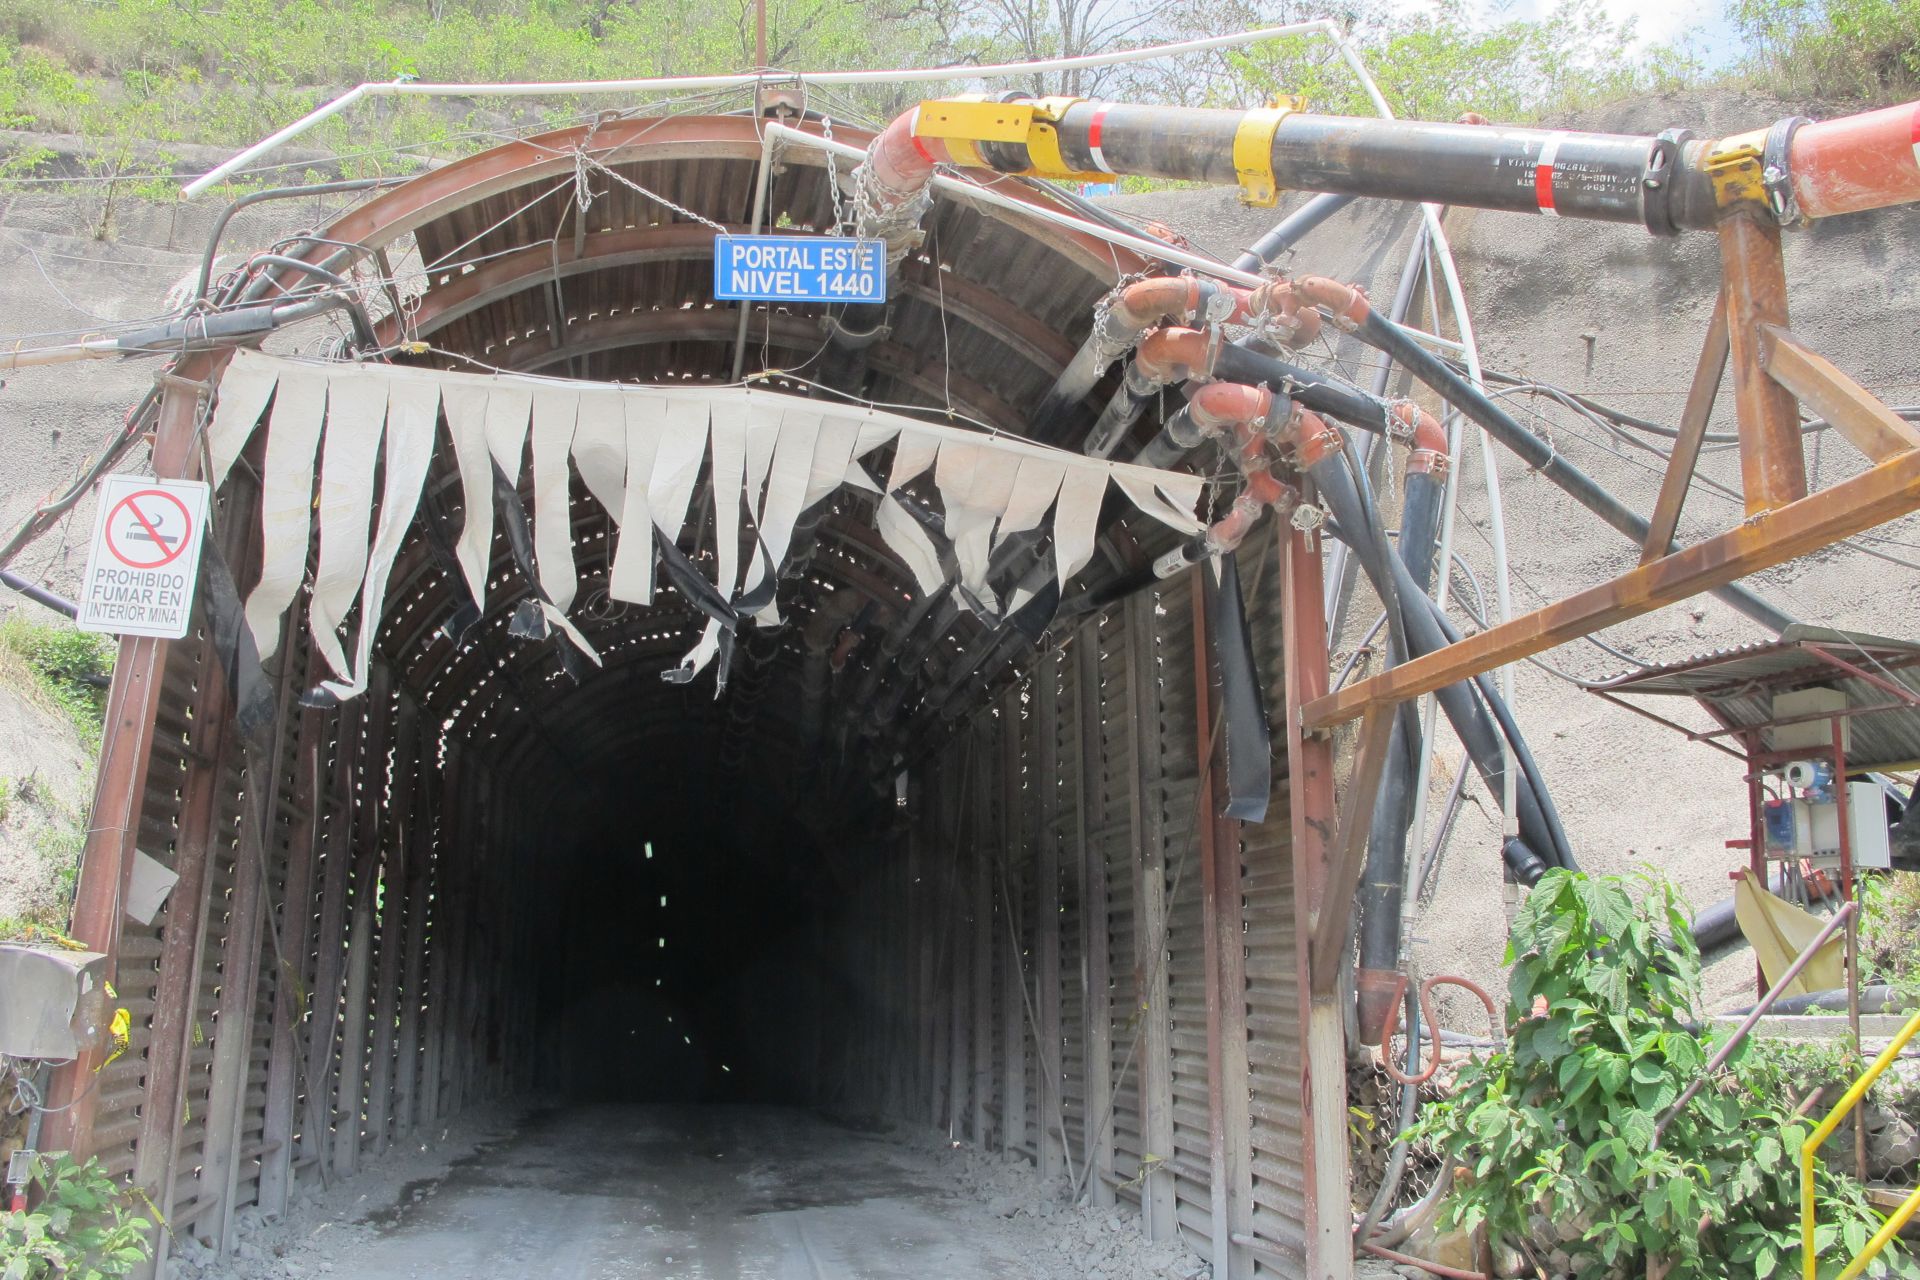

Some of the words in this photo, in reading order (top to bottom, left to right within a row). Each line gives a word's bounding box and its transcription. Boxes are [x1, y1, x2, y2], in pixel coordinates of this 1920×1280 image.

[732, 245, 815, 270] PORTAL
[820, 248, 874, 271] ESTE
[731, 270, 809, 295] NIVEL
[817, 273, 874, 296] 1440
[95, 568, 184, 590] PROHIBIDO
[92, 584, 153, 605] FUMAR
[158, 590, 182, 607] EN
[89, 602, 145, 622] INTERIOR
[147, 607, 178, 625] MINA
